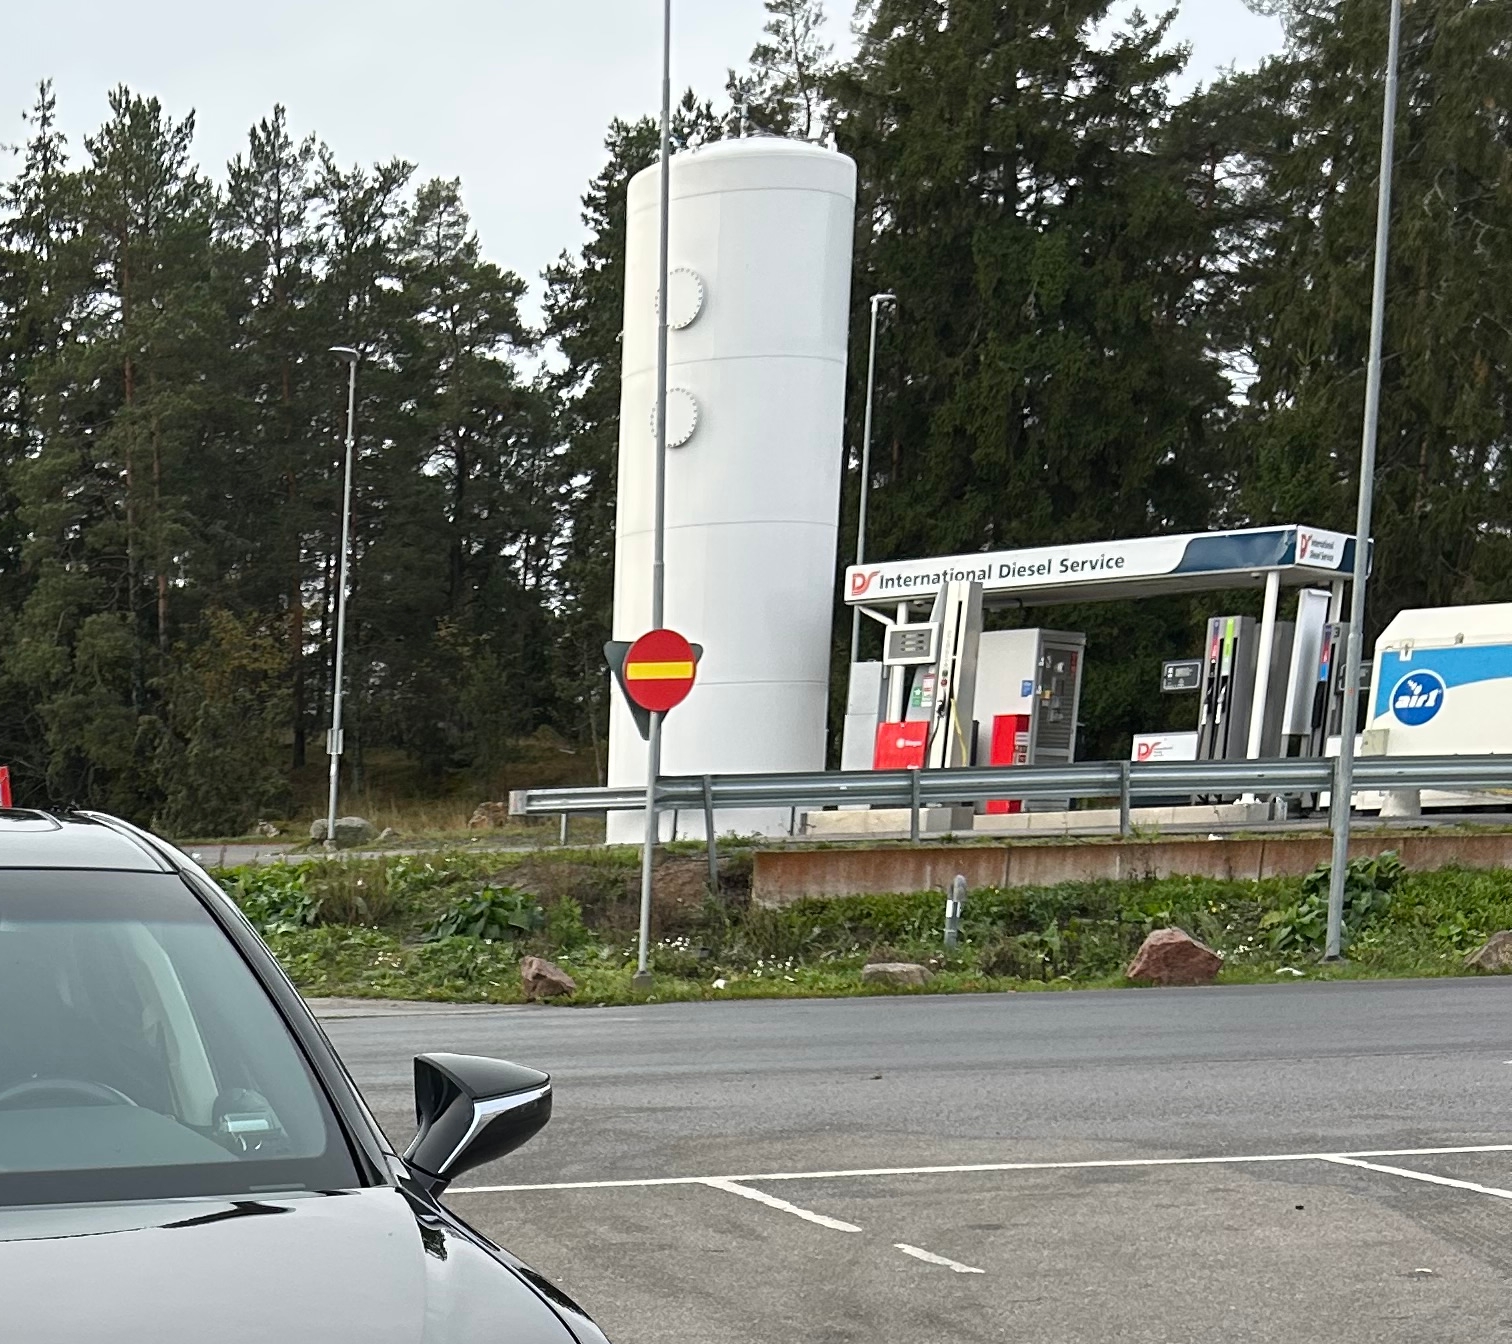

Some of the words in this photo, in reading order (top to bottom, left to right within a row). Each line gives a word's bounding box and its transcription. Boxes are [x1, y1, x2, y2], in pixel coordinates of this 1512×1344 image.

[879, 564, 992, 590] International
[999, 558, 1052, 579] Diesel
[1059, 553, 1125, 574] Service
